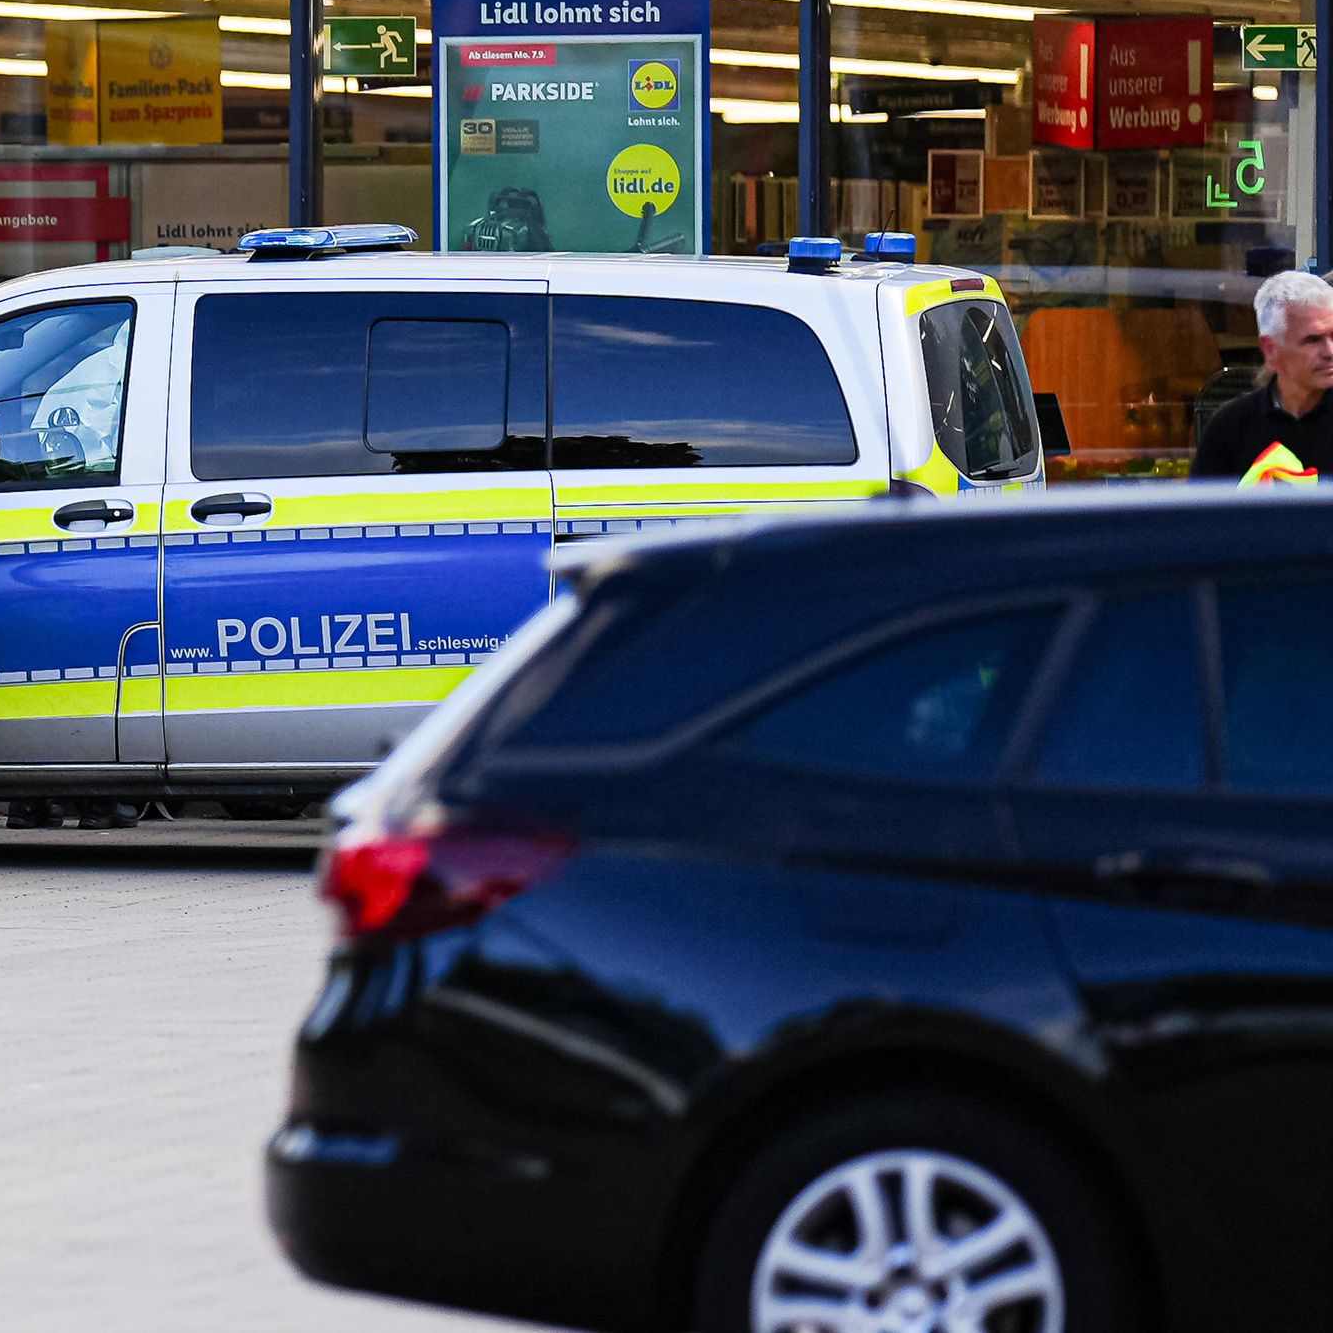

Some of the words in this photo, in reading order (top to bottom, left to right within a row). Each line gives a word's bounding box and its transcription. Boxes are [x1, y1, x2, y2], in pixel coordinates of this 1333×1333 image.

[480, 2, 528, 24] Lidl
[535, 2, 603, 23] lohnt
[609, 1, 661, 23] sich
[469, 51, 481, 60] Ab
[482, 50, 513, 59] diesem
[514, 50, 531, 59] Mo.
[1109, 45, 1136, 66] Aus
[491, 81, 594, 102] PARKSIDE
[1109, 76, 1164, 96] unserer
[627, 116, 656, 126] Lohnt
[657, 116, 680, 126] sich.
[1109, 106, 1181, 131] Werbung
[613, 178, 675, 194] lidl.de
[157, 224, 186, 238] Lidl
[191, 225, 233, 238] lohnt
